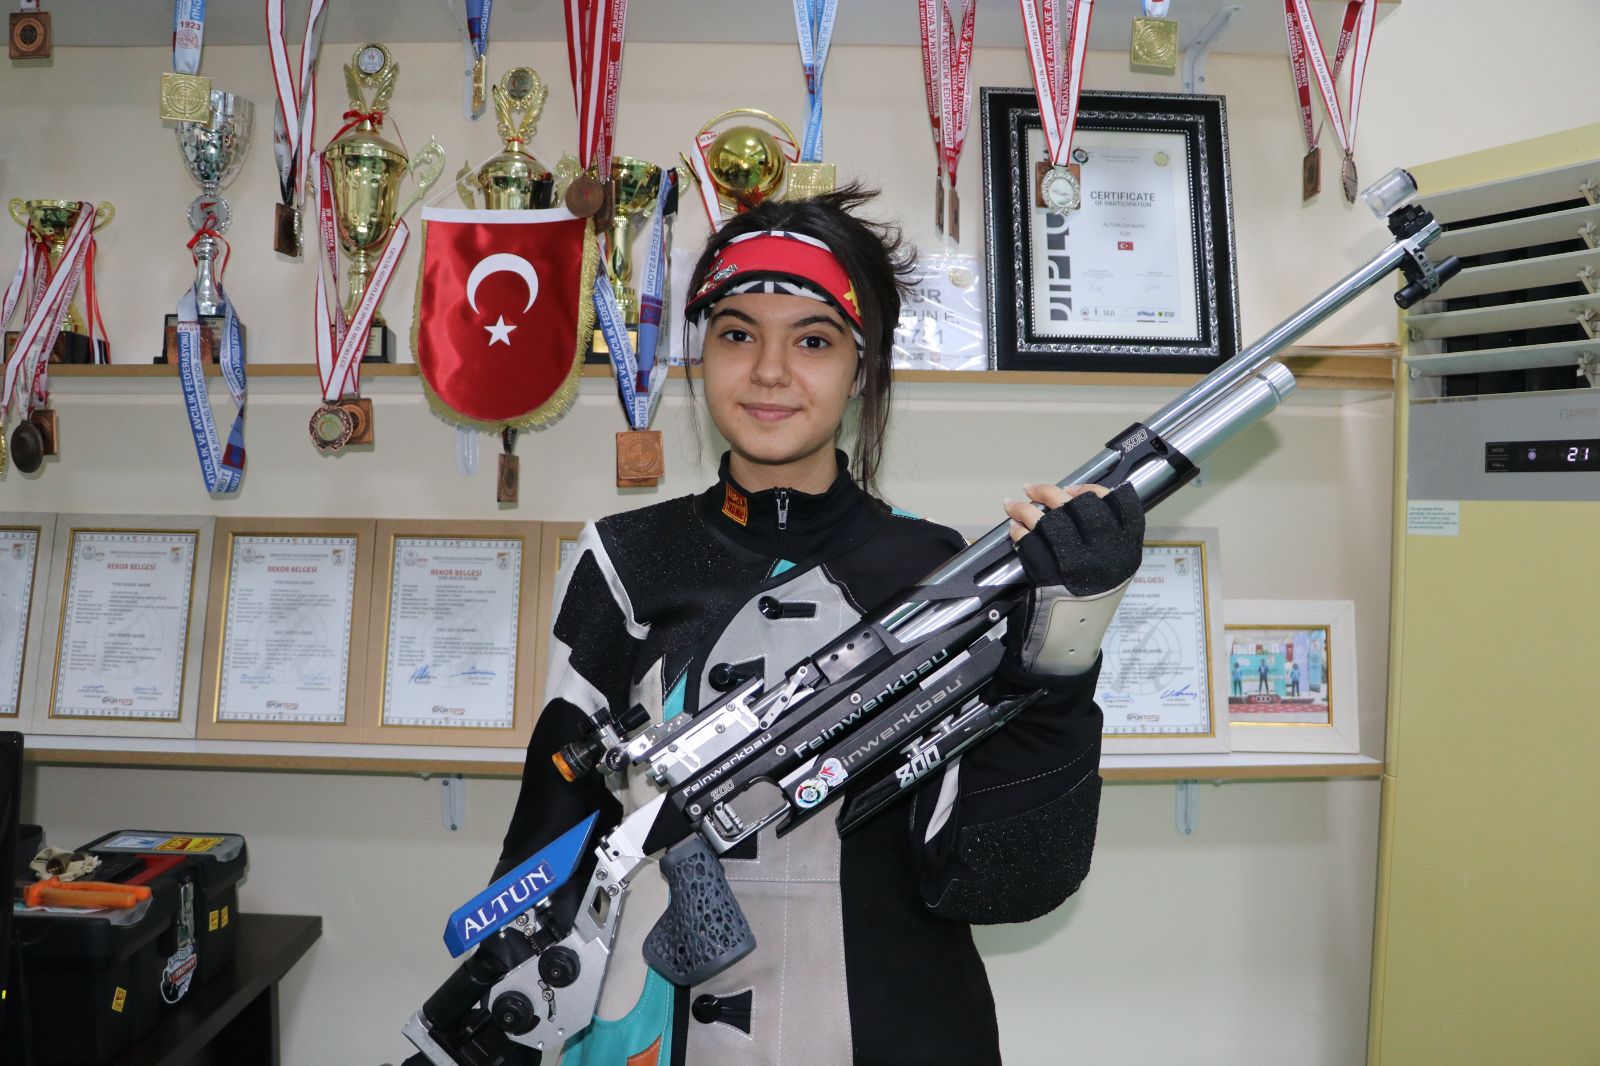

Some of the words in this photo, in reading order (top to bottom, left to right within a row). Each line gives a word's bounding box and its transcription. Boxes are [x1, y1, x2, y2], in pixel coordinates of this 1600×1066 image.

[180, 22, 200, 30] 1923
[1044, 10, 1052, 22] VE
[960, 40, 968, 52] VE
[1044, 24, 1054, 60] ATICILIK
[958, 54, 967, 88] ATICILIK
[1090, 190, 1156, 202] CERTIFICATE
[1104, 200, 1152, 208] PARTICIPATION
[609, 300, 627, 340] FEDERATION
[606, 326, 624, 360] AVCILIK
[624, 342, 638, 374] HUNTING
[180, 332, 194, 391] FEDERASYONU
[617, 362, 627, 376] VE
[194, 362, 208, 408] FEDERATION
[621, 378, 636, 416] ATICILIK
[188, 394, 202, 430] AVCILIK
[204, 410, 218, 444] HUNTING
[196, 432, 206, 446] VE
[1567, 447, 1590, 462] 21
[200, 446, 216, 484] ATICILIK
[454, 568, 482, 577] BELGESİ
[794, 648, 948, 760] Feinwerkbau
[841, 679, 962, 767] inwerkbau
[683, 733, 772, 797] Feinwerkbau
[895, 744, 941, 789] 800
[464, 864, 551, 940] ALTUN
